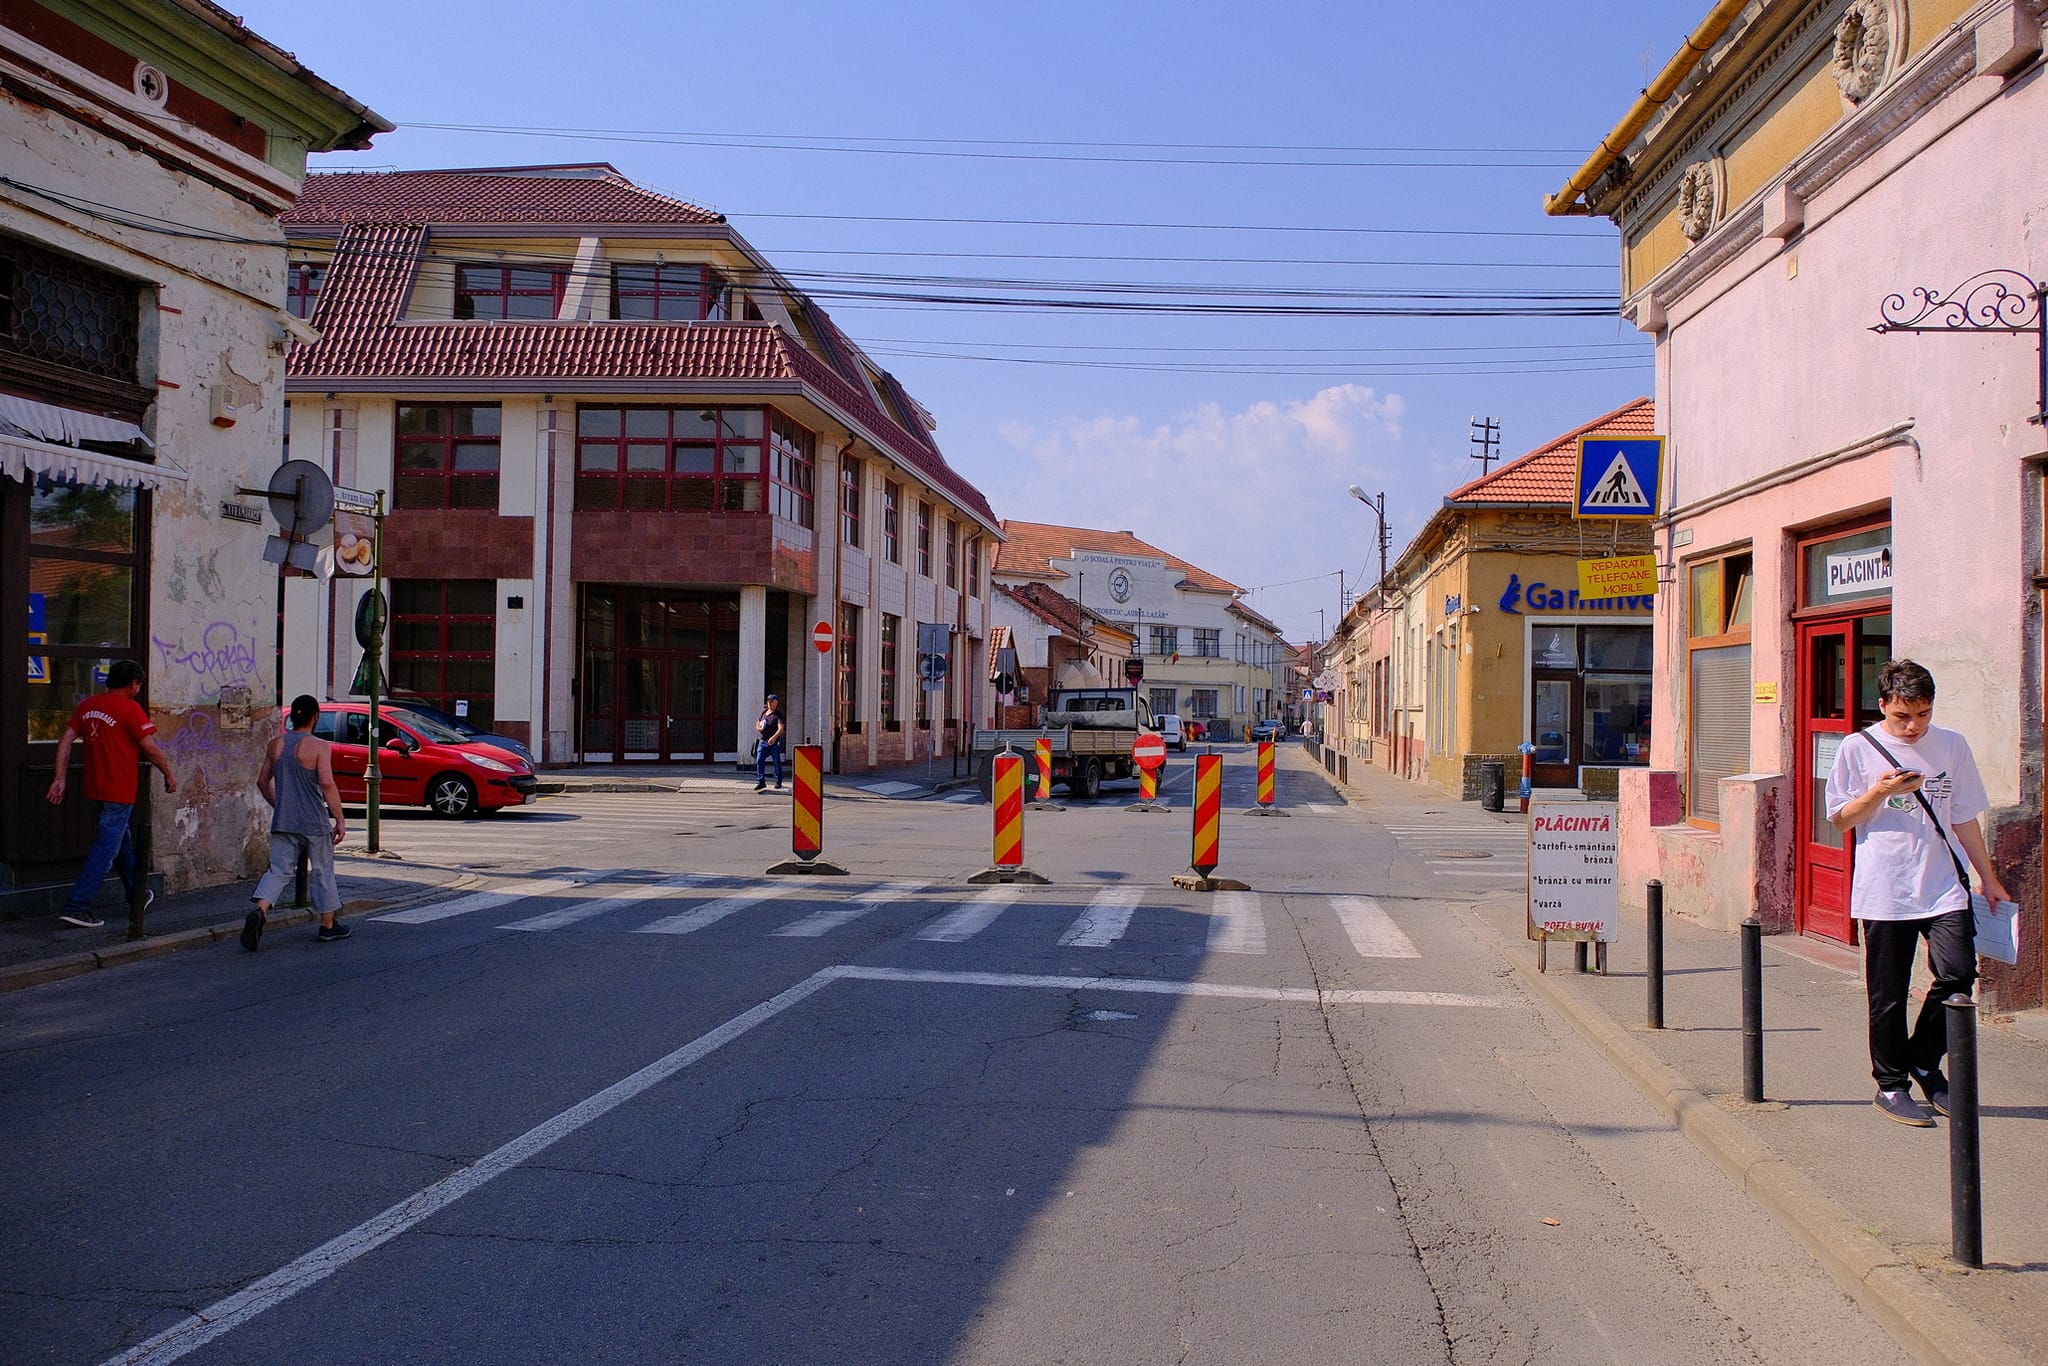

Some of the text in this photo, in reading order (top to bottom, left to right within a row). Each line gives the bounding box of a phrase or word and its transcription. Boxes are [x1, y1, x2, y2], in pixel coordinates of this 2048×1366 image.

[1587, 570, 1651, 584] TELEFOANE
[1602, 582, 1643, 595] MOBILE
[1571, 877, 1582, 885] cu
